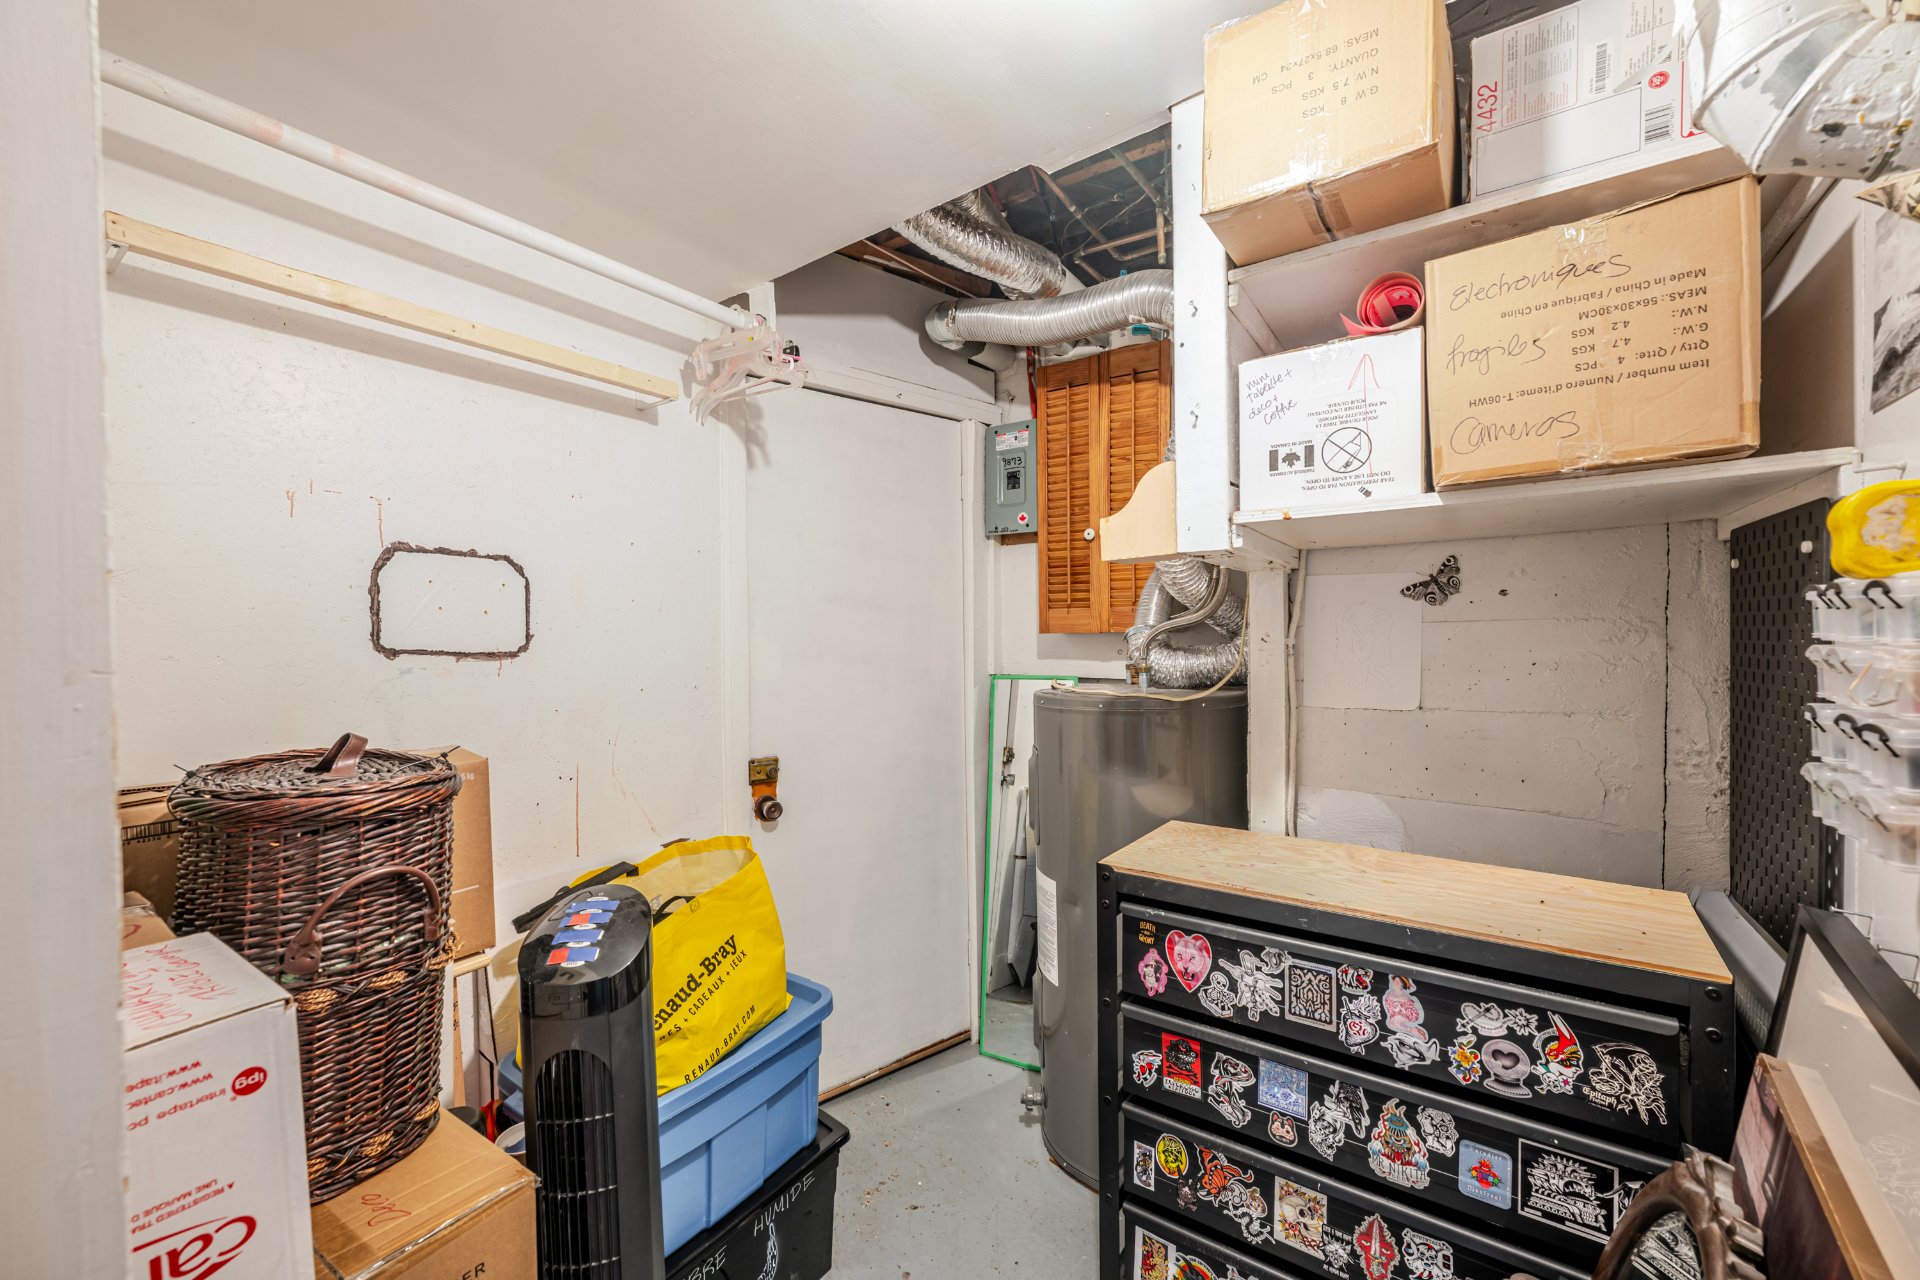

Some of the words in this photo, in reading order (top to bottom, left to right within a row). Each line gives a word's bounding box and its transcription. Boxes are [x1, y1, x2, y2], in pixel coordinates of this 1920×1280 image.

[1344, 28, 1378, 48] MEAS:
[1329, 48, 1378, 72] QUANTY:
[1252, 72, 1268, 84] CM
[1308, 72, 1314, 80] 3
[1272, 80, 1292, 94] PCS
[1302, 86, 1324, 100] KGS
[1340, 96, 1347, 106] 8
[1476, 81, 1498, 132] 4432
[1302, 104, 1325, 118] KGS
[1655, 276, 1666, 286] in
[1668, 267, 1707, 283] Made
[1616, 279, 1650, 294] China
[1552, 288, 1603, 309] Fabrique
[1500, 306, 1532, 320] Chine
[1534, 302, 1548, 311] en
[1578, 296, 1658, 320] 56x30x30CM
[1612, 319, 1630, 331] 4.2
[1571, 326, 1596, 339] KGS
[1612, 336, 1632, 348] 4.7
[1680, 339, 1710, 353] Qtty
[1572, 343, 1596, 356] KGS
[1635, 348, 1668, 360] Qtte:
[1574, 360, 1598, 372] PCS
[1618, 354, 1626, 365] 4
[1679, 358, 1710, 370] Item
[1626, 364, 1676, 380] number
[1566, 374, 1614, 390] Numero
[1002, 456, 1022, 467] 9873
[1140, 922, 1156, 934] DEATH
[1138, 934, 1154, 945] GLORY
[688, 976, 725, 1016] CADEAUX
[731, 949, 748, 971] JEUX
[684, 1004, 756, 1085] RENAUD-BRAY.COM
[156, 1088, 226, 1120] intertape
[1582, 1085, 1618, 1110] Epitaph
[753, 1170, 816, 1237] HUMIDE
